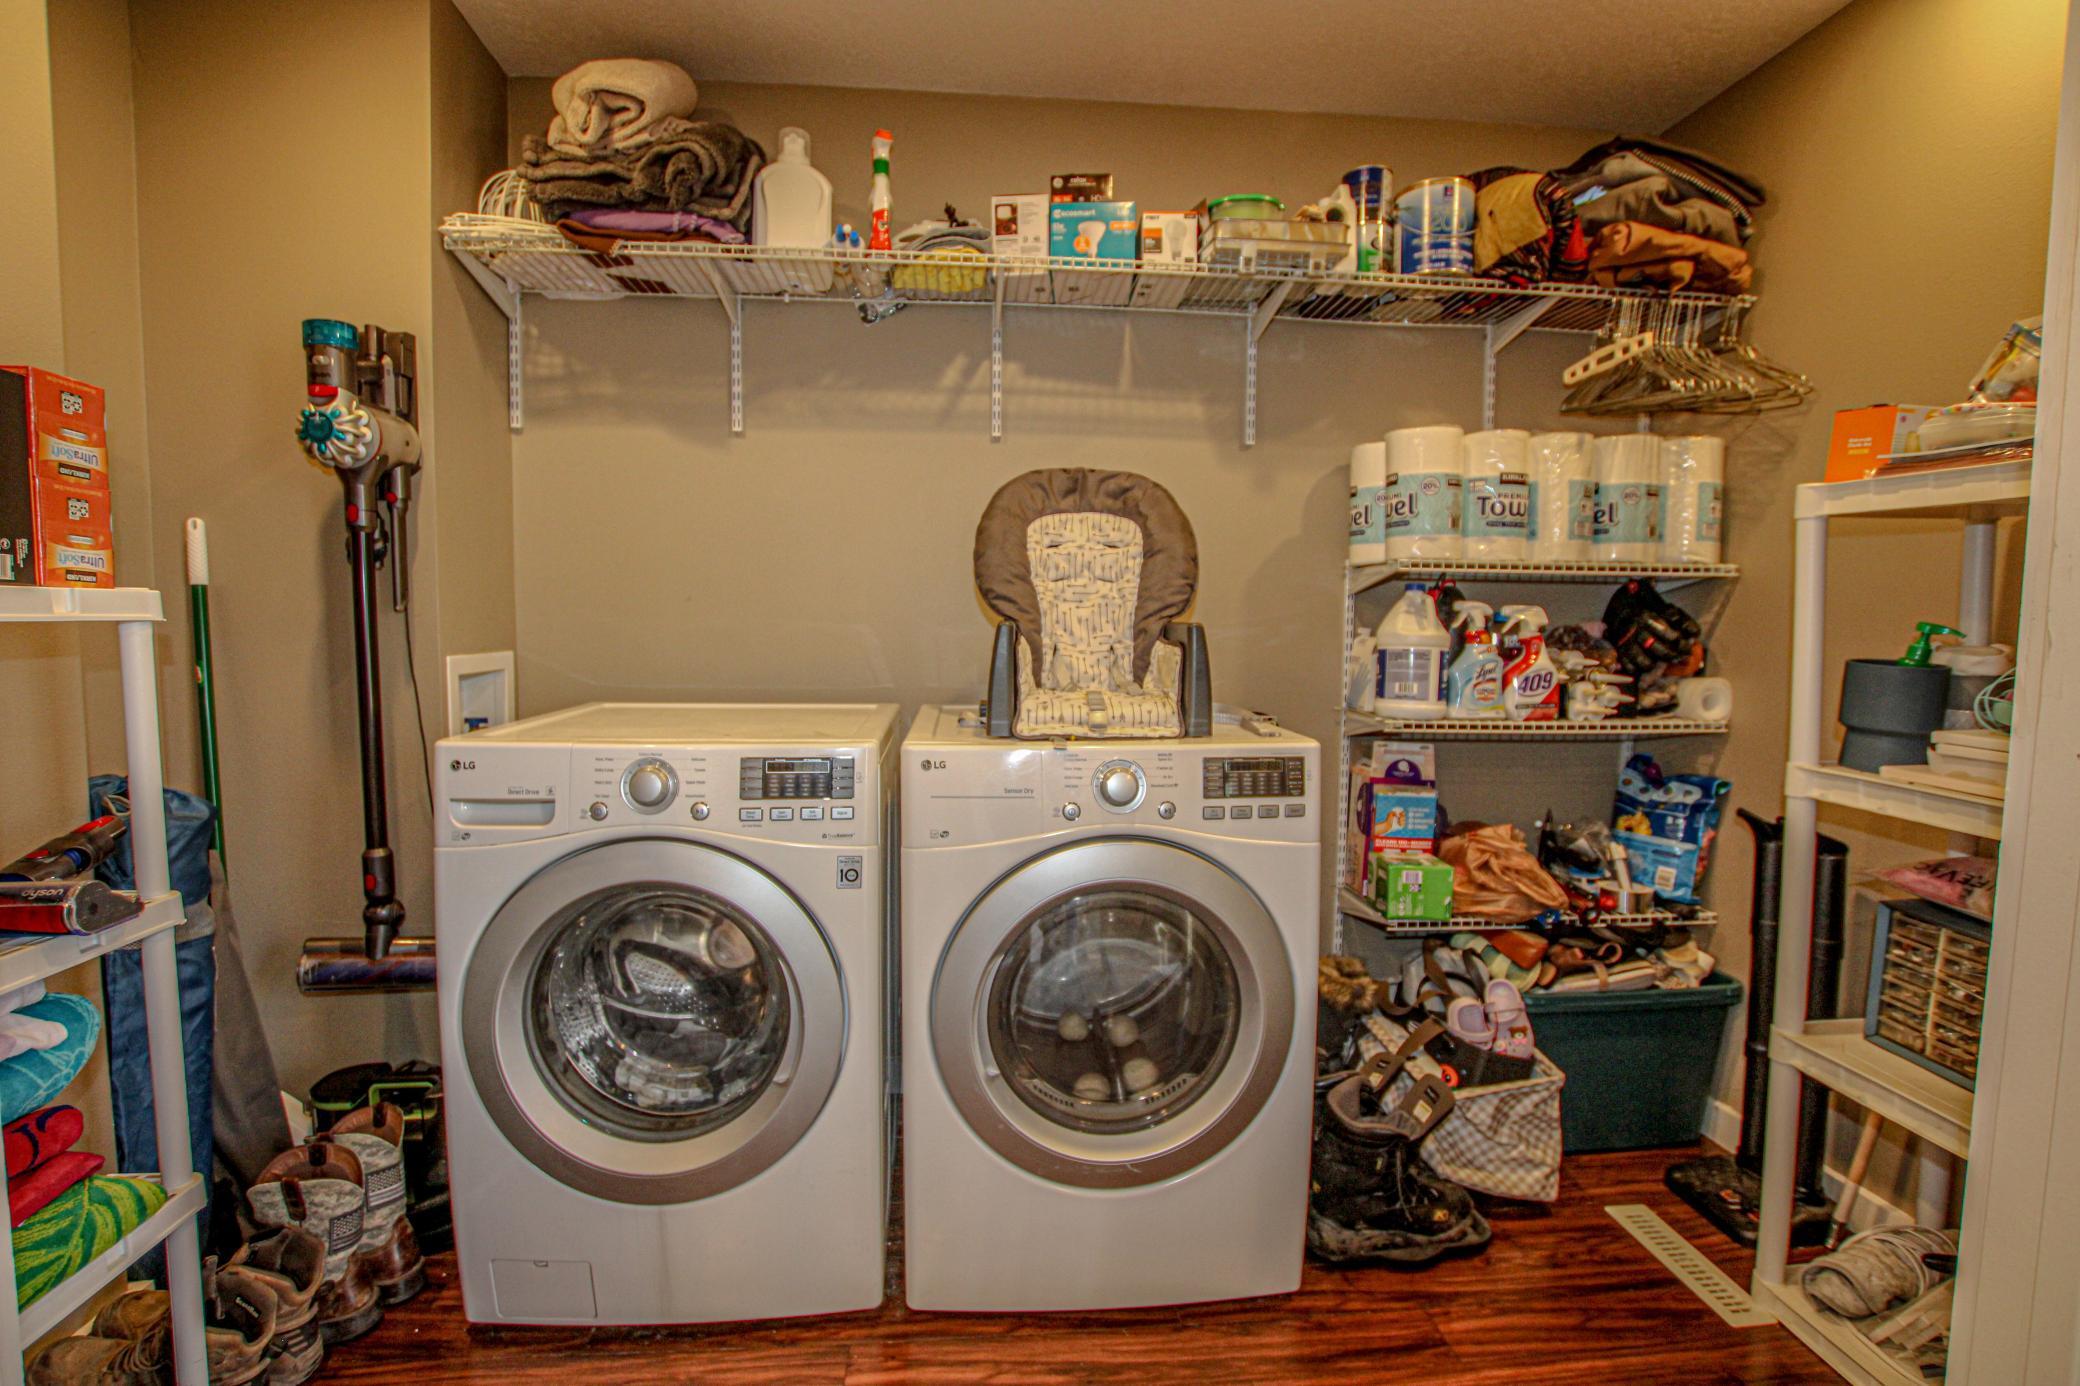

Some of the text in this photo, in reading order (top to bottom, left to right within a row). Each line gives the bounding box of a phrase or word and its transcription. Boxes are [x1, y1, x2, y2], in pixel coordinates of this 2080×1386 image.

[1477, 496, 1527, 517] Tow
[1518, 672, 1553, 692] 409
[463, 761, 476, 770] LG
[933, 760, 947, 769] LG
[21, 888, 65, 900] dyson
